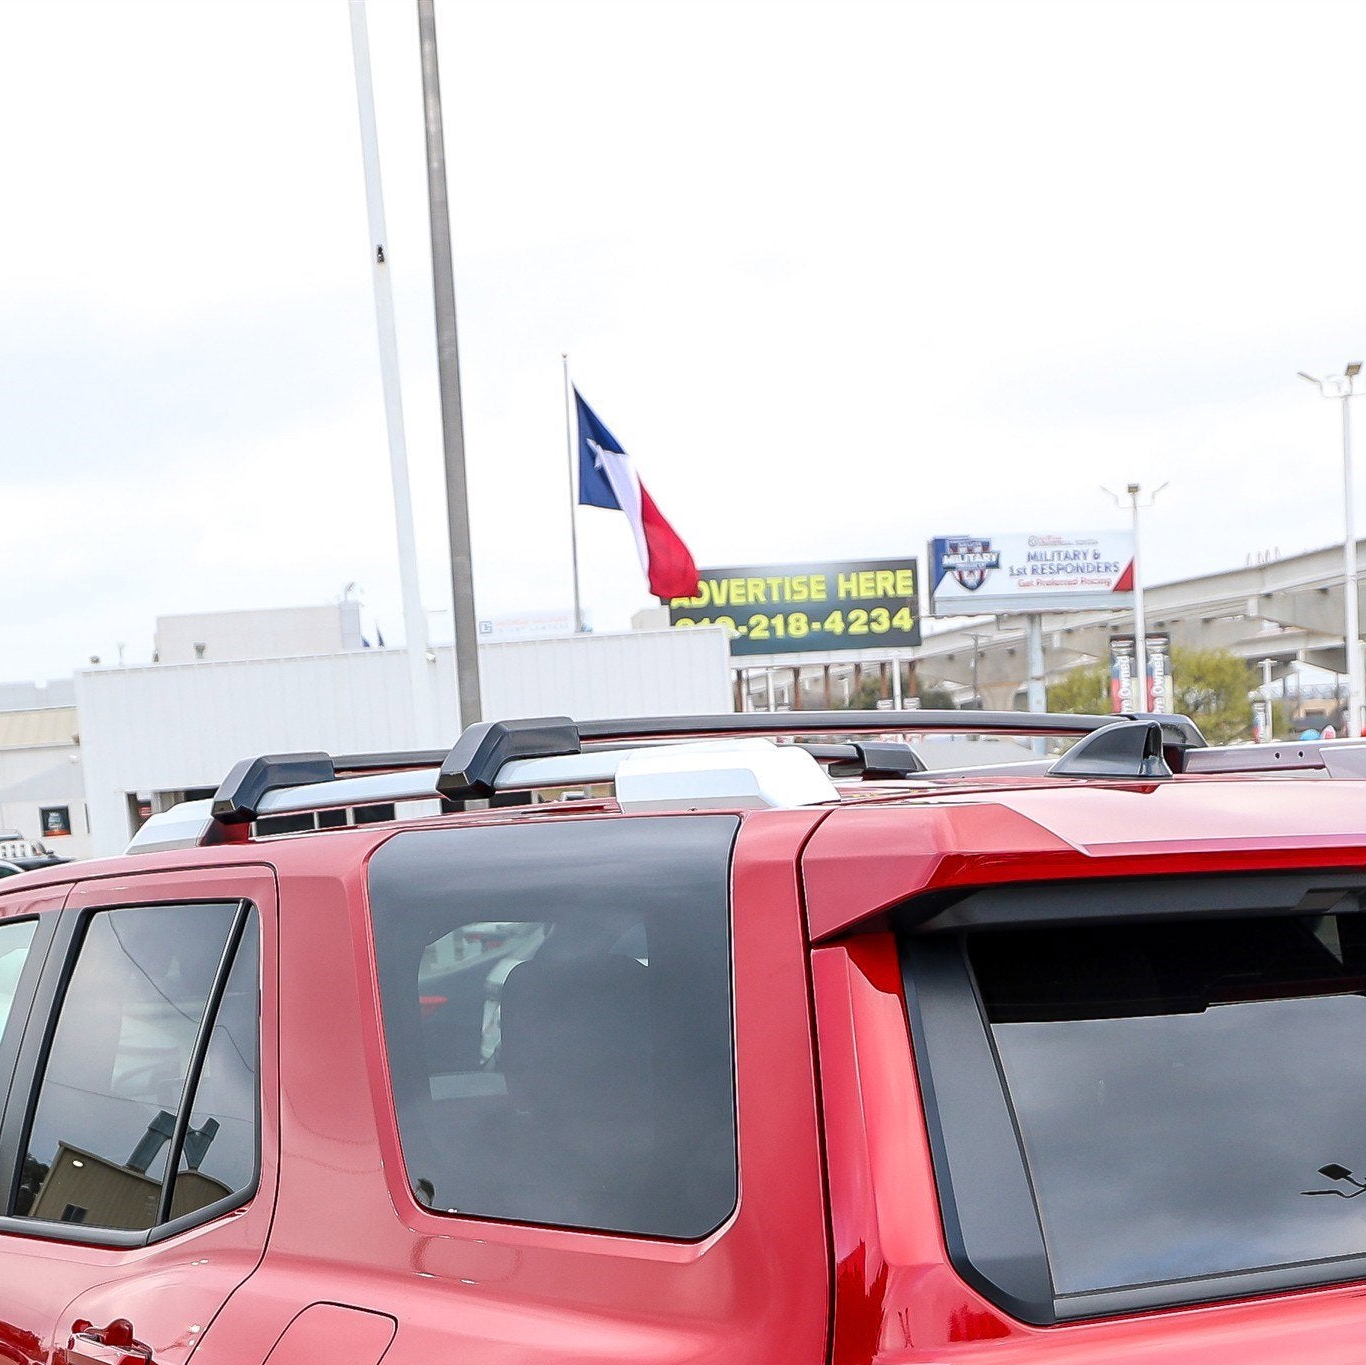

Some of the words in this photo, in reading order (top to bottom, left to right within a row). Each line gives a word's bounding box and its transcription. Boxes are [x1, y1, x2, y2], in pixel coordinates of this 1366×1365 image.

[941, 552, 999, 566] MILITARY
[1026, 549, 1088, 562] MILITARY
[1031, 561, 1120, 575] RESPONDERS
[837, 569, 915, 601] HERE
[1116, 655, 1132, 698] Owned
[1149, 654, 1165, 696] Owned
